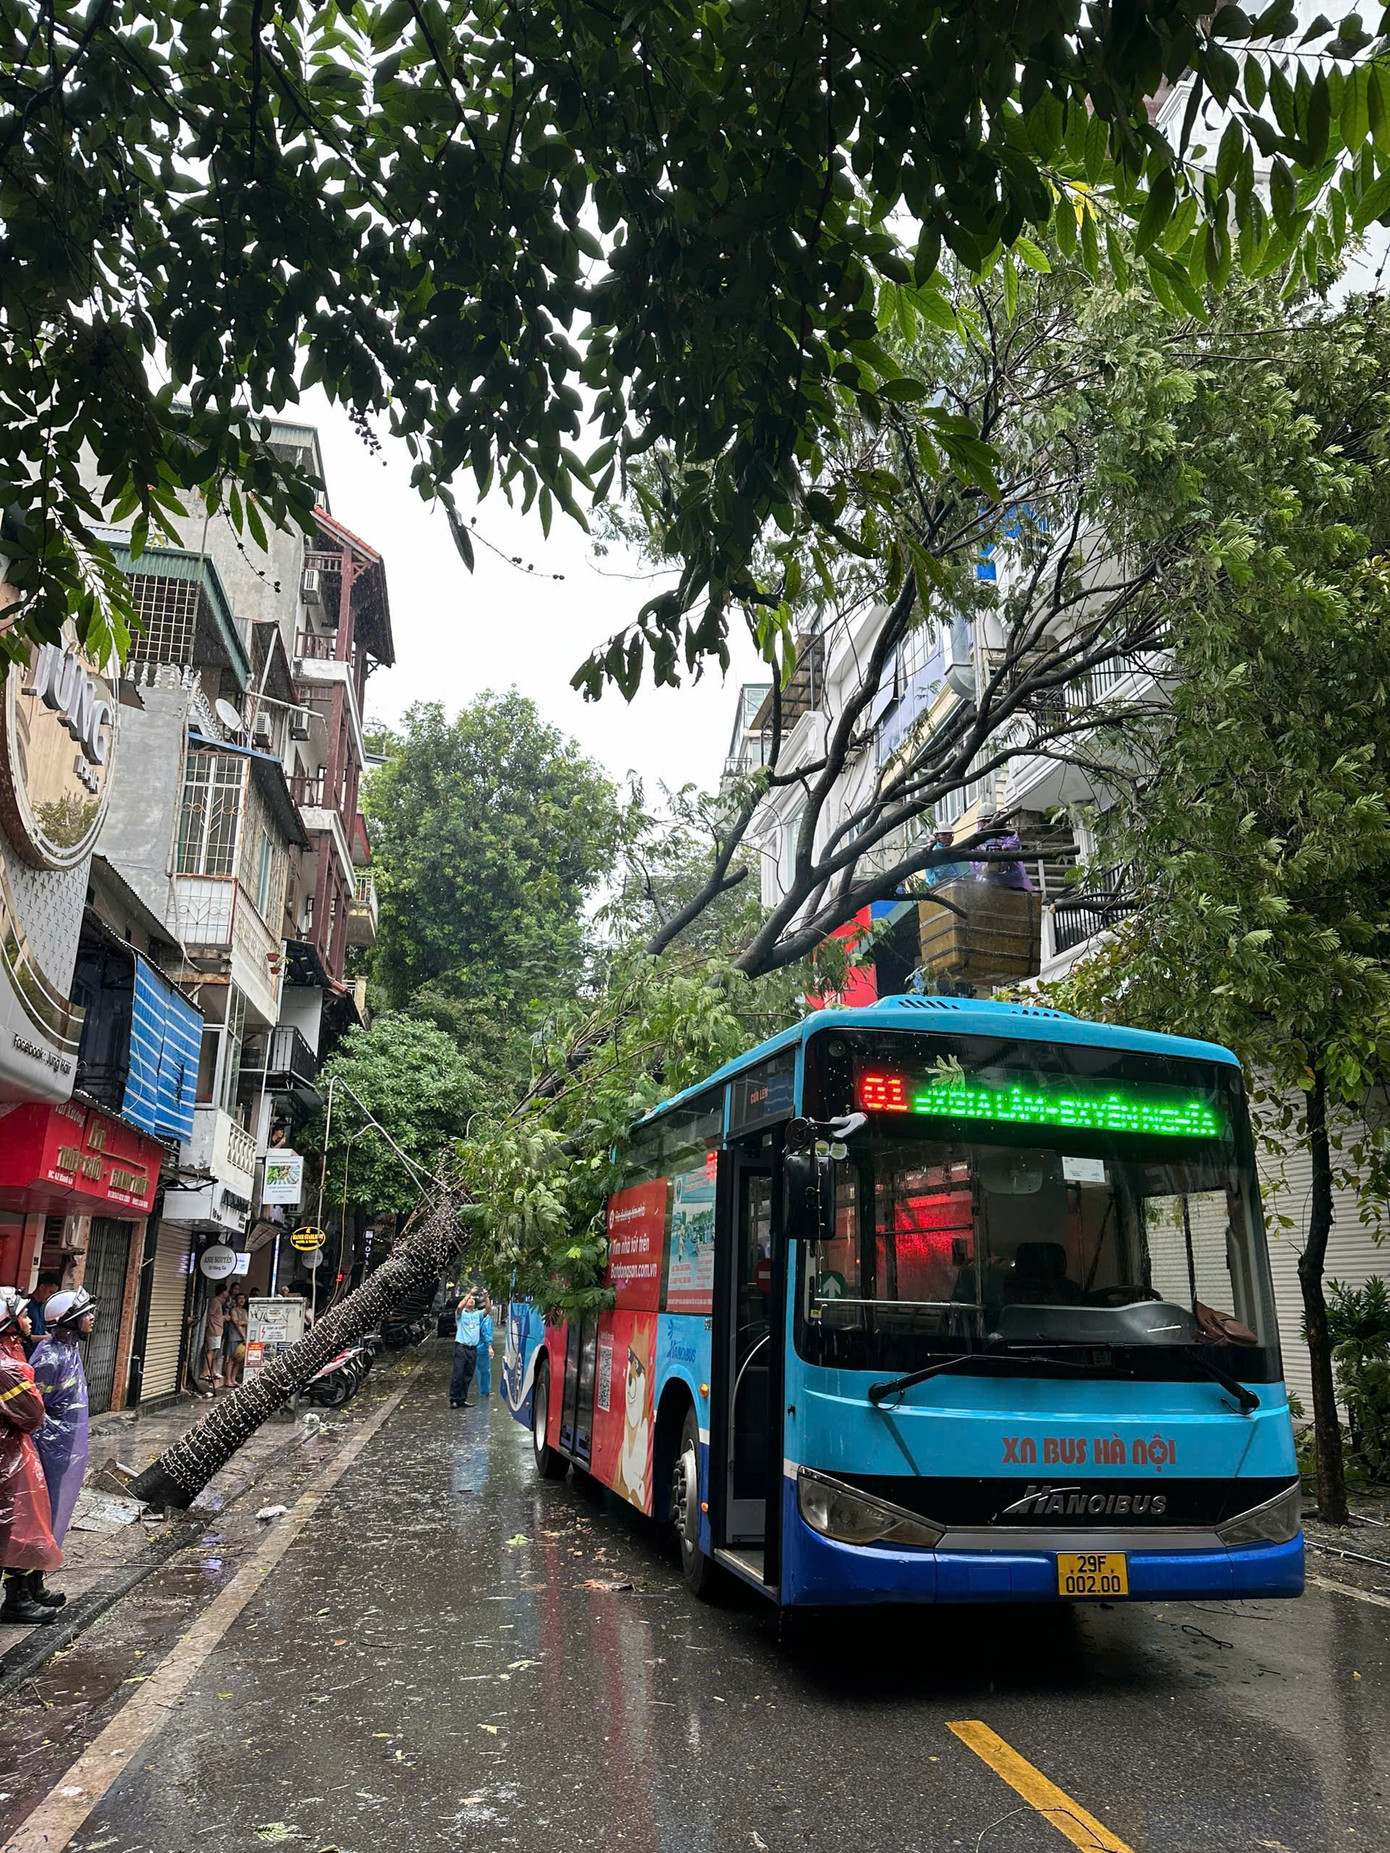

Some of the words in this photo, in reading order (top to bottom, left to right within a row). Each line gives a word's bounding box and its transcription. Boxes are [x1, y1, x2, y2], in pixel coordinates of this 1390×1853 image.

[621, 1235, 631, 1254] nhà
[630, 1231, 639, 1253] tốt
[638, 1233, 650, 1252] trên
[610, 1263, 658, 1284] Batdongsan.com.vn
[1002, 1437, 1037, 1464] XN
[1043, 1437, 1087, 1464] BUS
[1093, 1433, 1126, 1465] HÀ
[1132, 1433, 1176, 1472] NỘI
[1001, 1485, 1167, 1514] HANOIBUS
[1077, 1555, 1107, 1573] 29F
[1065, 1575, 1120, 1593] 002.00
